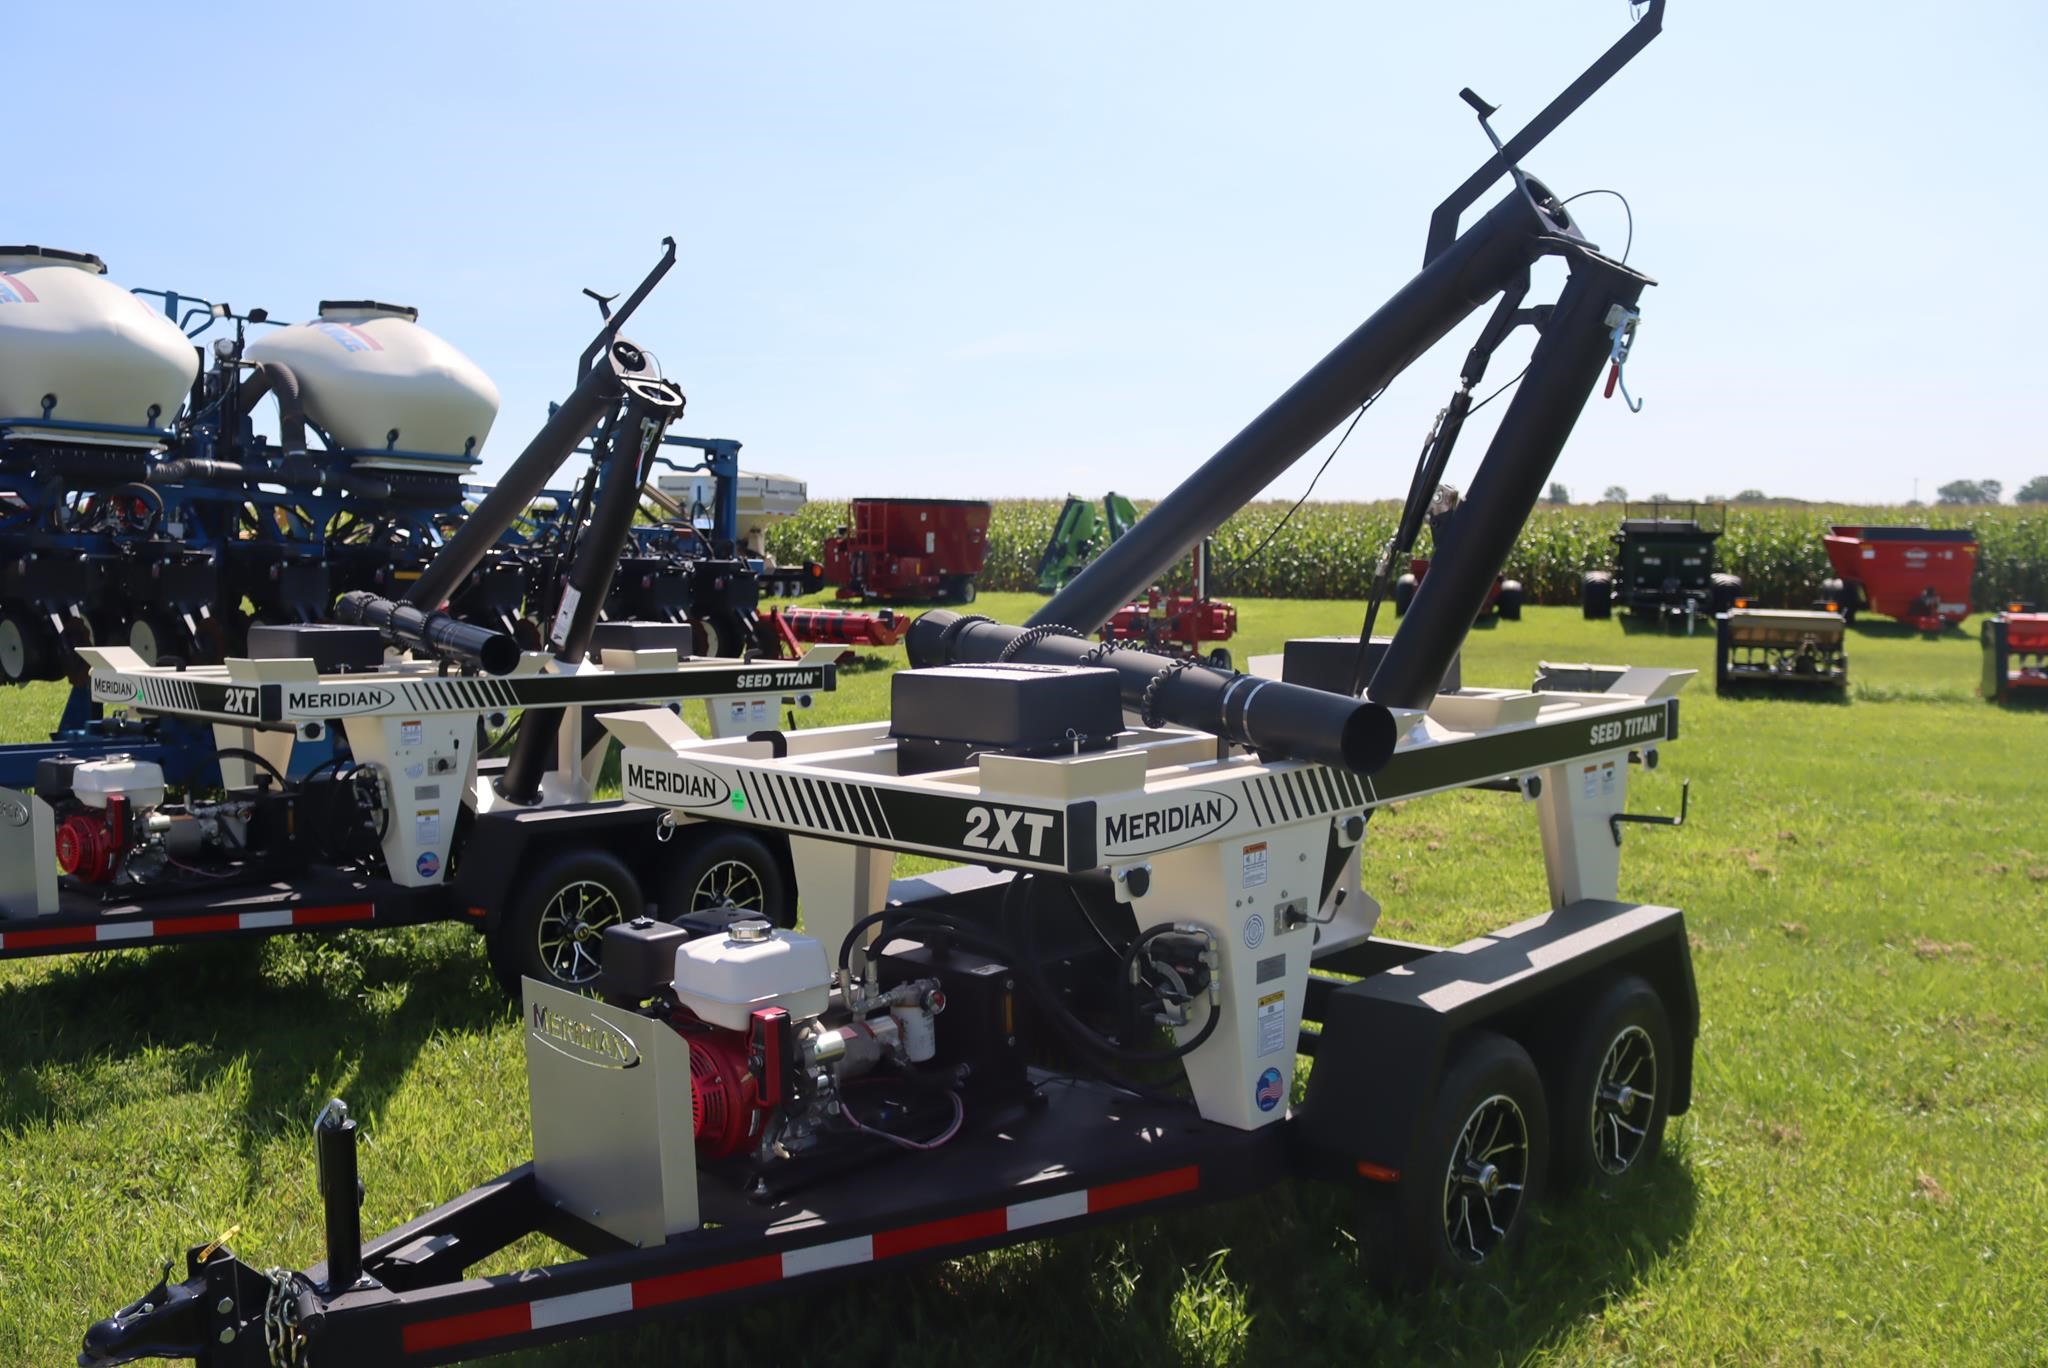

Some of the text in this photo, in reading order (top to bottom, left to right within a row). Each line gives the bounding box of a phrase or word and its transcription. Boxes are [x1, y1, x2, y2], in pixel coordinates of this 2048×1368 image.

[94, 678, 133, 696] MERIDIAN
[736, 673, 773, 689] SEED
[224, 688, 257, 714] 2XT
[289, 691, 382, 709] MERIDIAN
[1589, 721, 1622, 746] SEED
[627, 763, 717, 799] MERIDIAN
[962, 806, 1055, 857] 2XT
[1105, 798, 1223, 847] MERIDIAN
[531, 1001, 630, 1063] MERIDIAN
